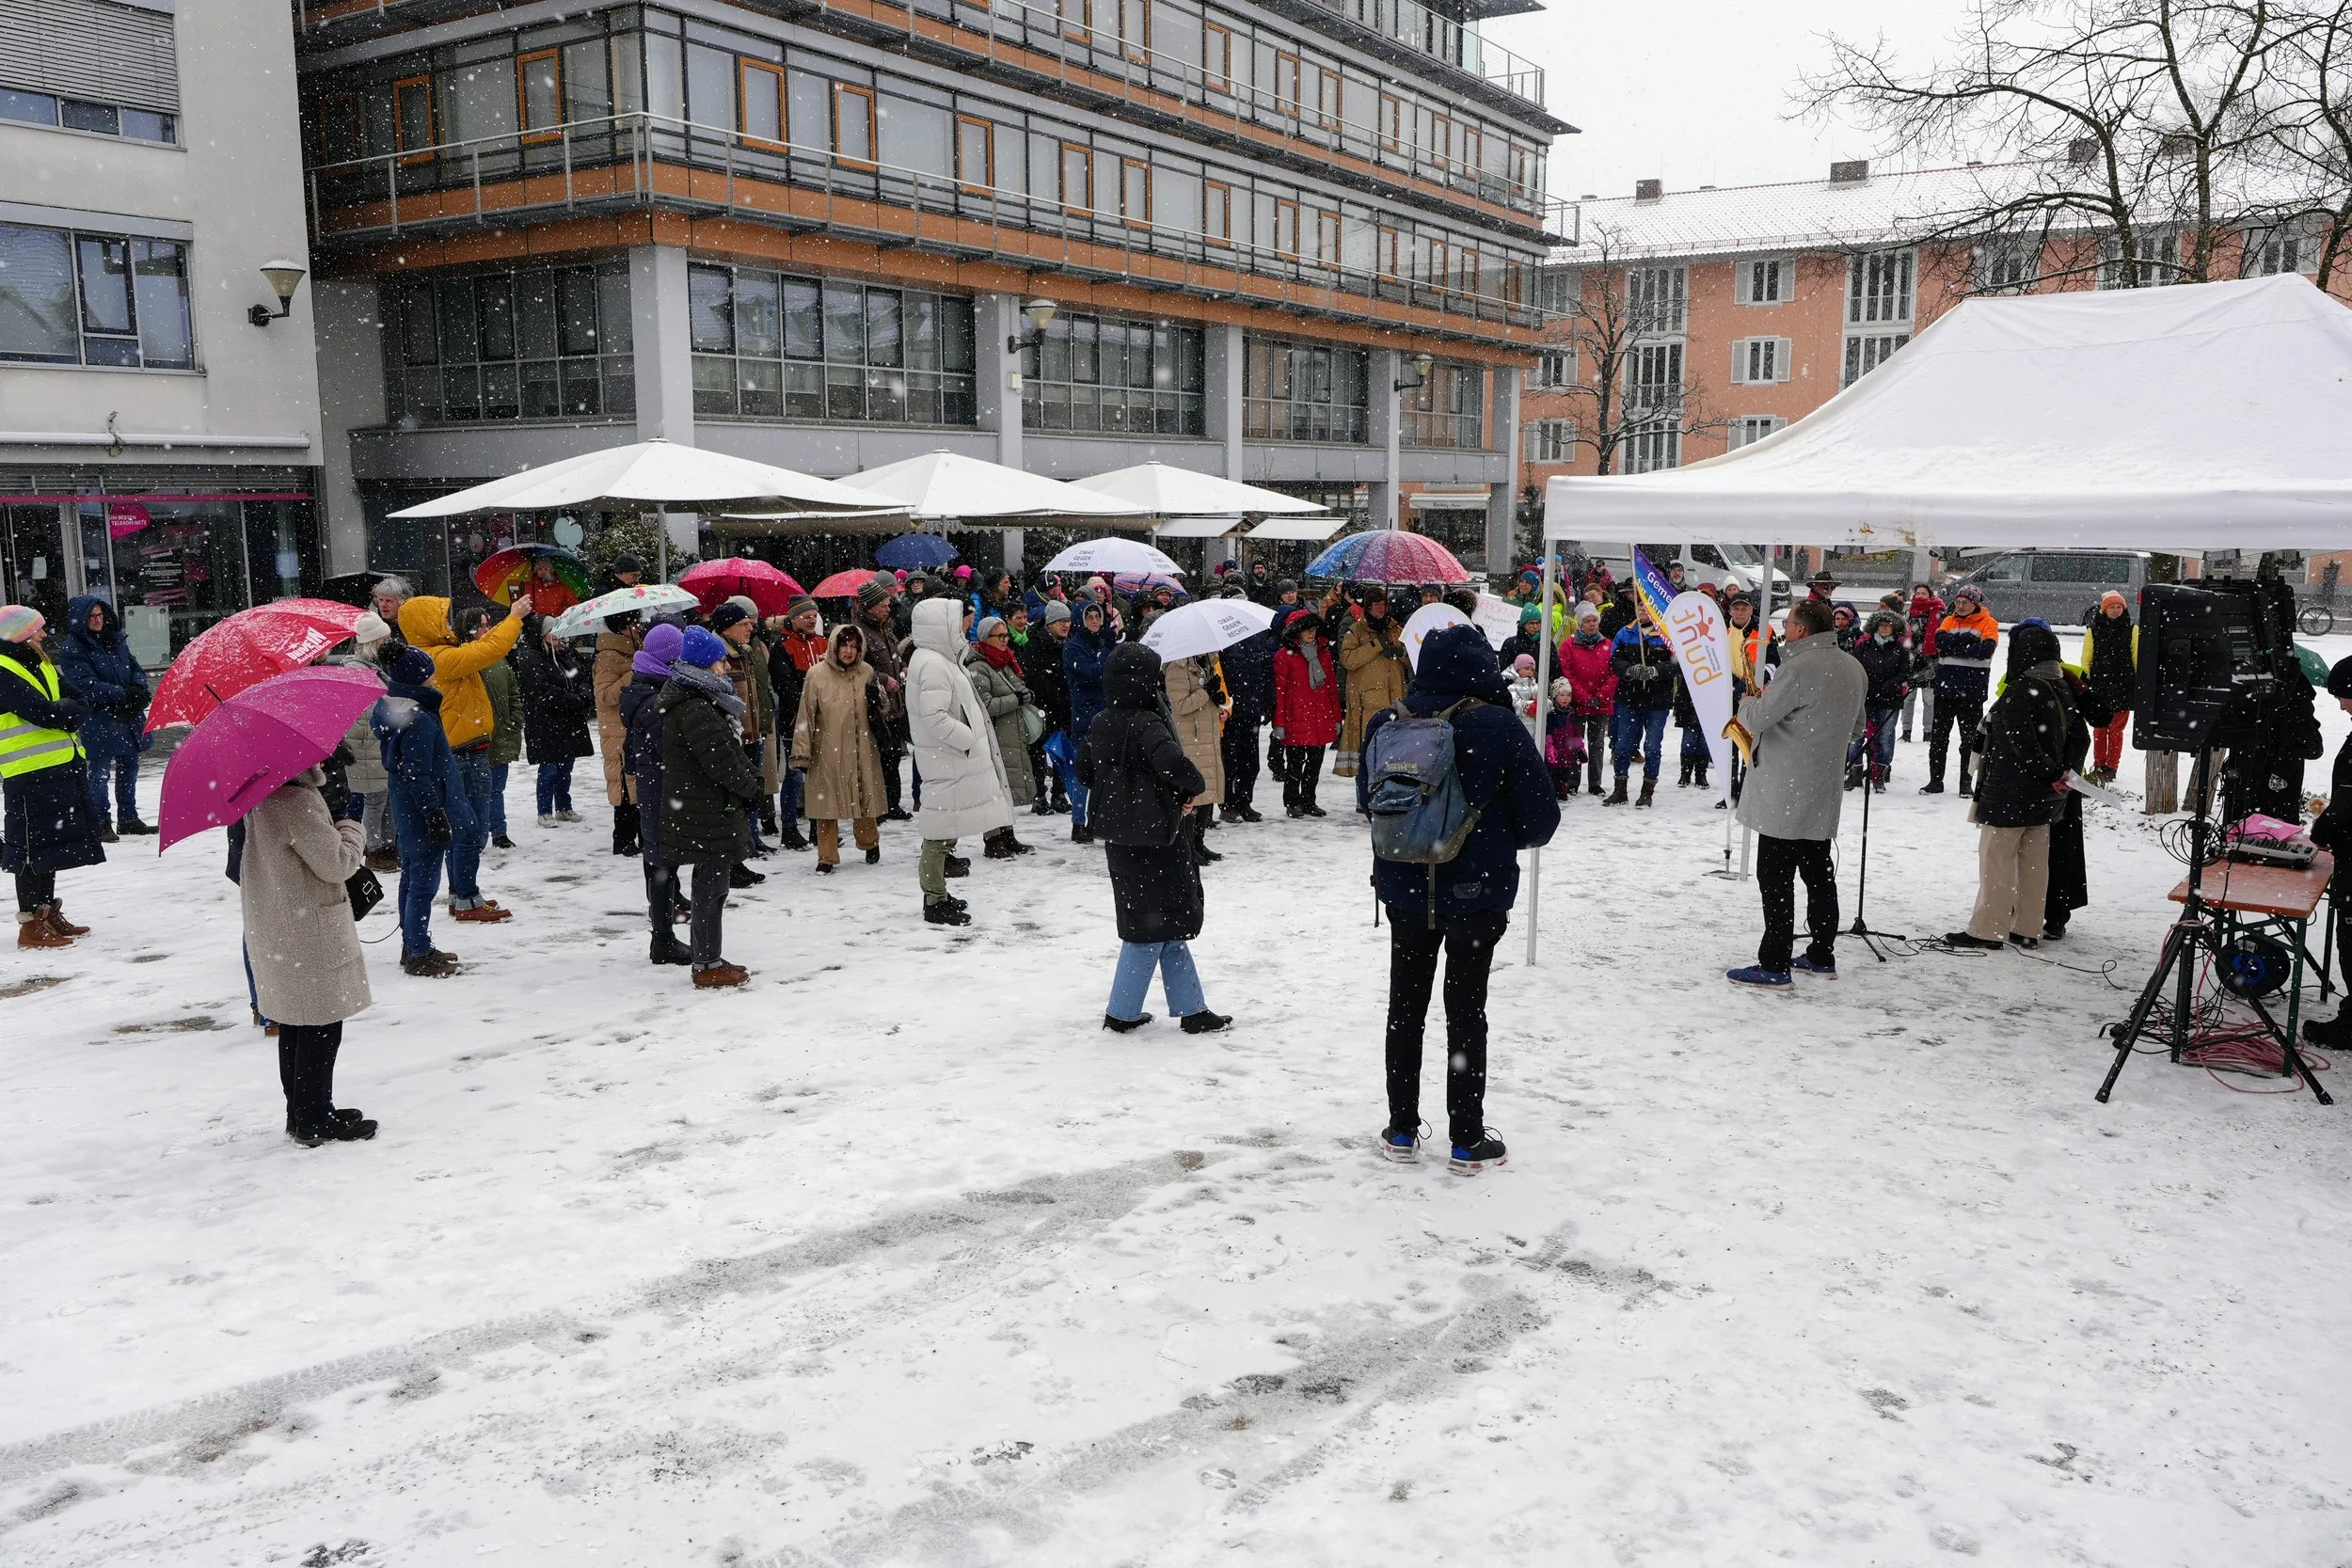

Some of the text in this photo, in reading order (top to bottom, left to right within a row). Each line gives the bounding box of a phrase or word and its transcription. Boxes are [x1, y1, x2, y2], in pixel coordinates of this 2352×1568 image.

[1647, 571, 1673, 604] Geme
[1648, 594, 1663, 620] Dem
[1217, 615, 1234, 625] OMAS
[1222, 620, 1242, 631] GEGEN
[1227, 626, 1249, 639] RECHTS
